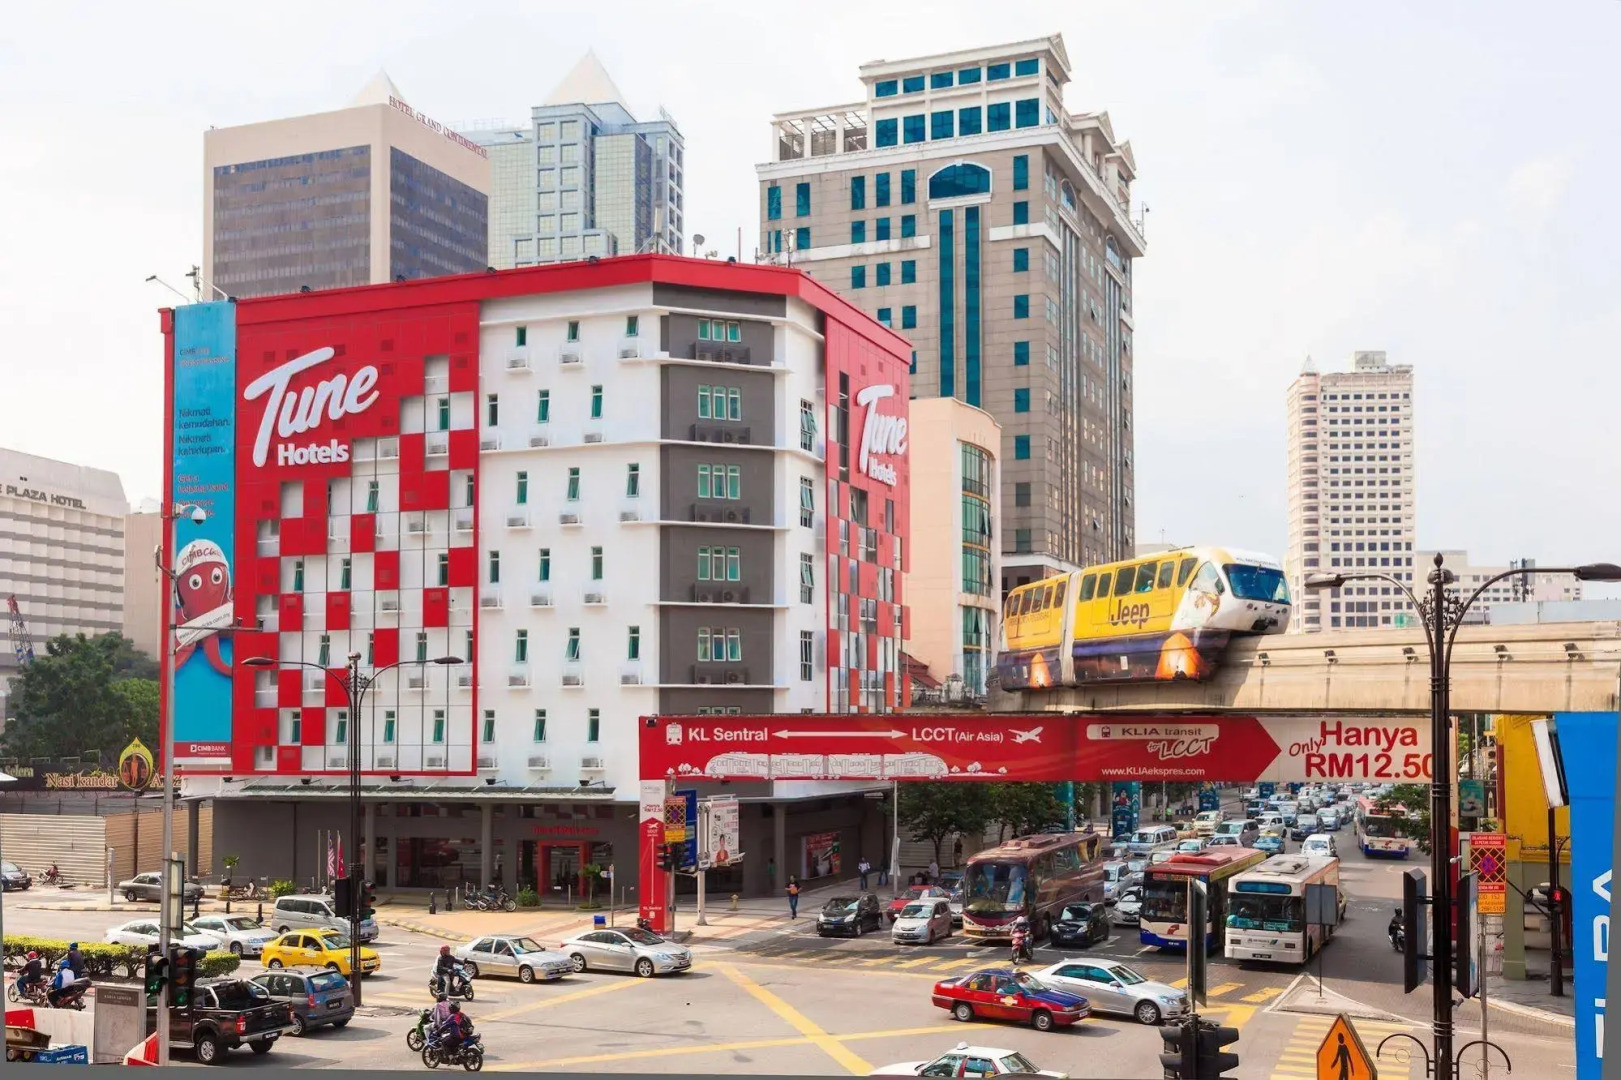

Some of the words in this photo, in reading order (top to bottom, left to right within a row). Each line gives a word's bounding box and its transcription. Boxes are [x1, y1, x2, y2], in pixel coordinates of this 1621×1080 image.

[389, 95, 414, 118] HOTEL
[416, 112, 442, 133] GRAND
[443, 127, 488, 159] CONTINENTAL
[179, 407, 211, 418] Nikmati
[243, 346, 380, 468] Tune
[178, 434, 211, 444] Nikmati
[857, 385, 907, 474] Tune
[277, 439, 349, 466] Hotels
[868, 456, 897, 487] Hotels
[6, 485, 47, 501] PLAZA
[51, 494, 86, 509] HOTEL
[1110, 598, 1150, 629] Jeep
[688, 728, 710, 741] KL
[713, 727, 768, 742] Sentral
[912, 727, 955, 742] LCCT
[955, 732, 973, 743] (Air
[976, 732, 1004, 743] Asia)
[1121, 728, 1160, 736] KLIA
[1165, 728, 1202, 736] transit
[1320, 720, 1418, 753] Hanya
[1148, 743, 1160, 752] to
[1160, 737, 1214, 760] LCCT
[1288, 737, 1323, 757] Only
[46, 772, 74, 788] Nasi
[77, 773, 119, 788] kandar
[1101, 766, 1205, 776] www.KLIAekspres.com
